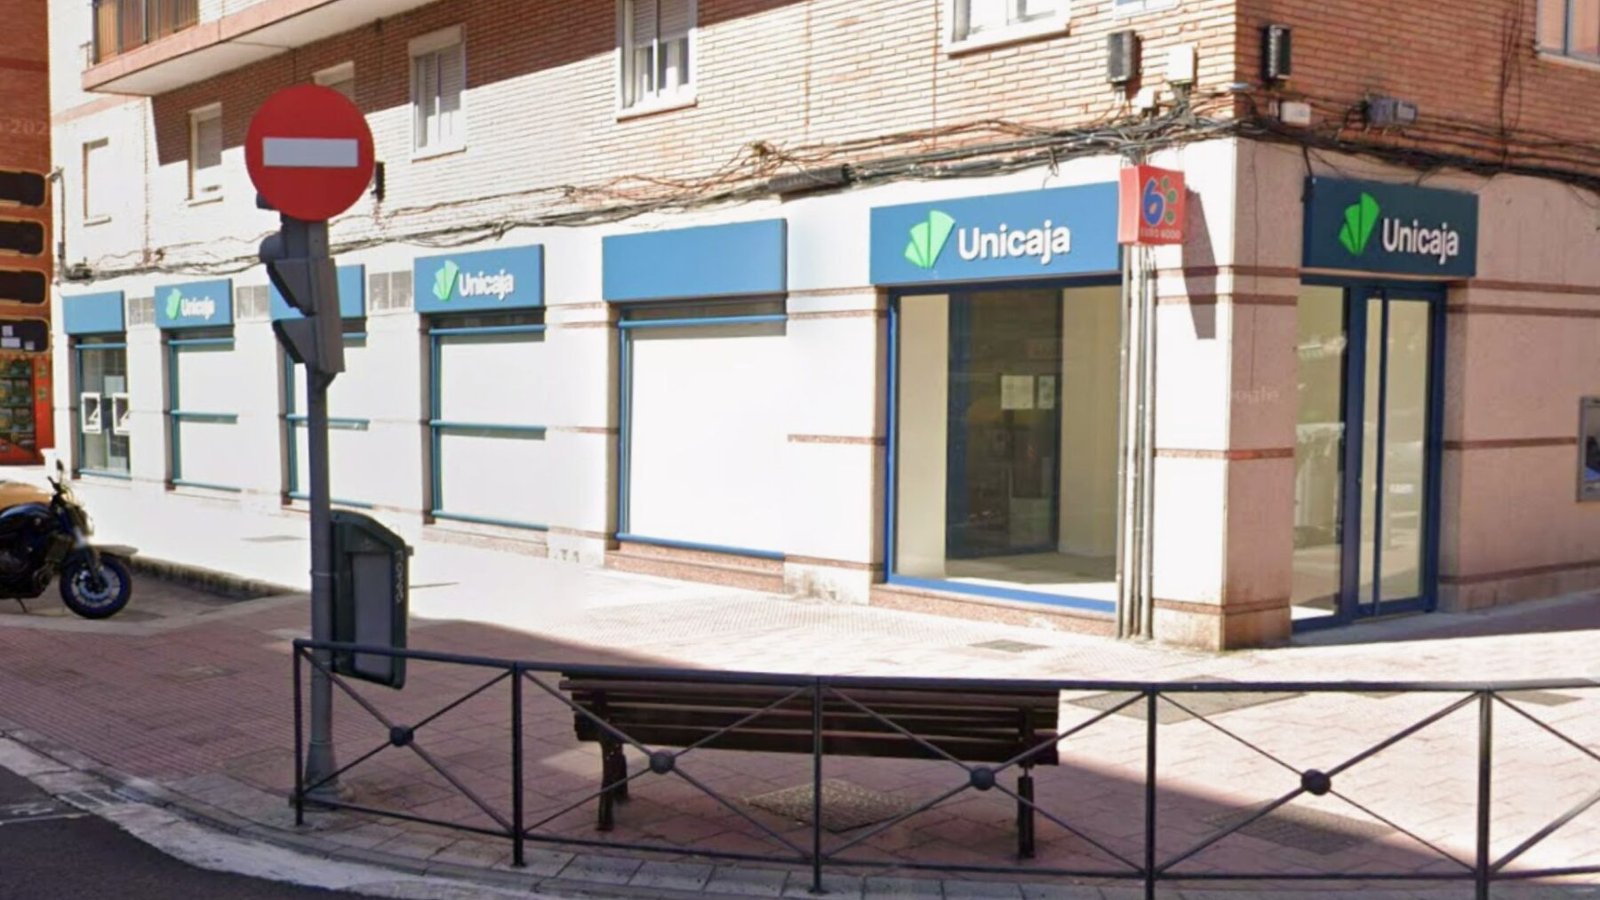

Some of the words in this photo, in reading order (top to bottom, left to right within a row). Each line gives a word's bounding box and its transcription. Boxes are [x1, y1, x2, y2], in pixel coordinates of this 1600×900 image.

[1142, 177, 1166, 228] 6
[957, 219, 1071, 266] Unicaja
[1382, 217, 1460, 265] Unicaja
[180, 296, 216, 320] Unicaja
[458, 268, 515, 301] Unicaja
